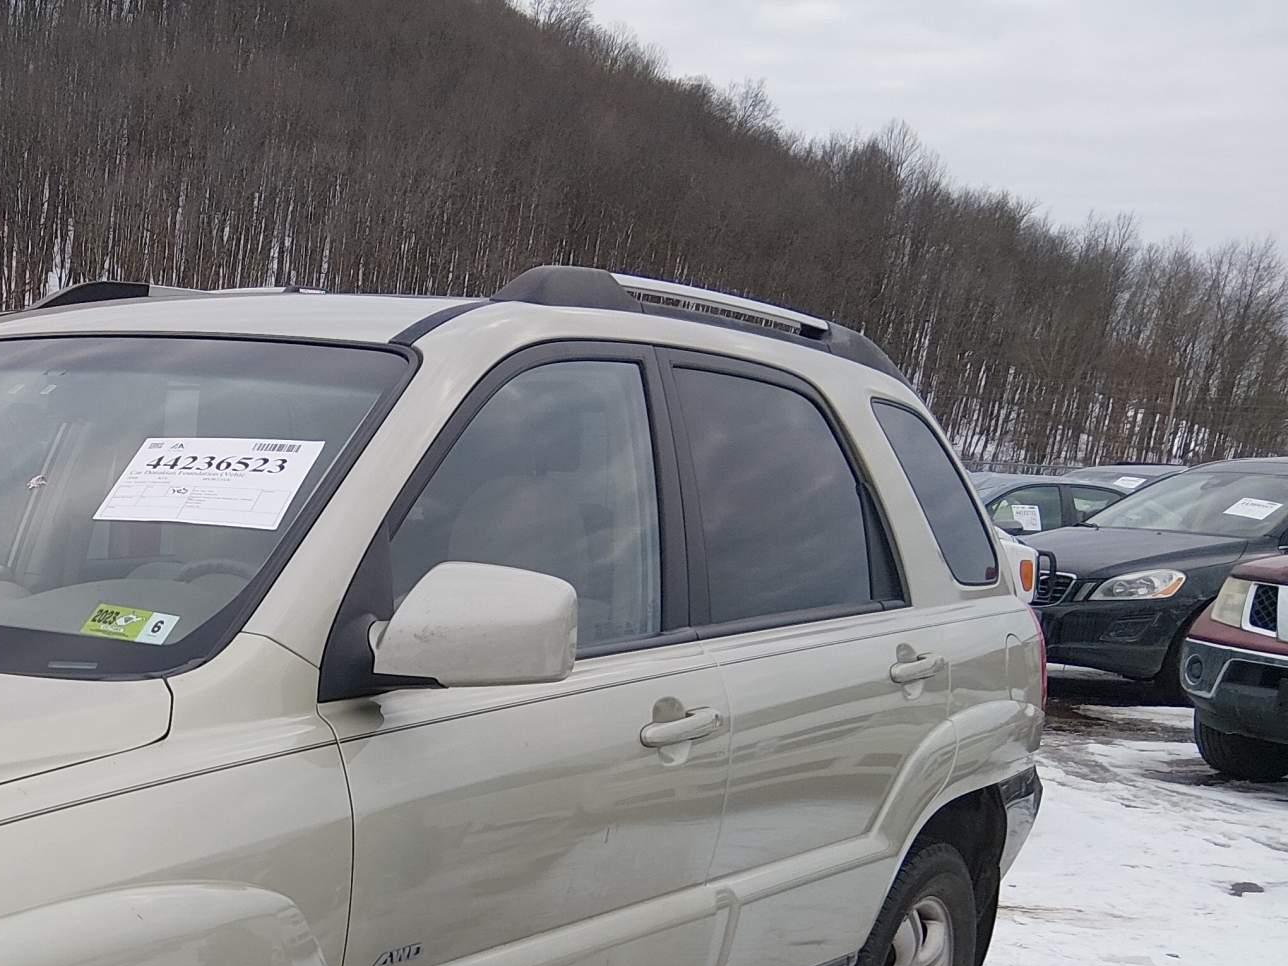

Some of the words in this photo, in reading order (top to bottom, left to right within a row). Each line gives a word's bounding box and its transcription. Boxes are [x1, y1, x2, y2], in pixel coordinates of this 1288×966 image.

[146, 455, 288, 474] 44236523
[91, 609, 120, 625] 2023
[151, 620, 165, 633] 6
